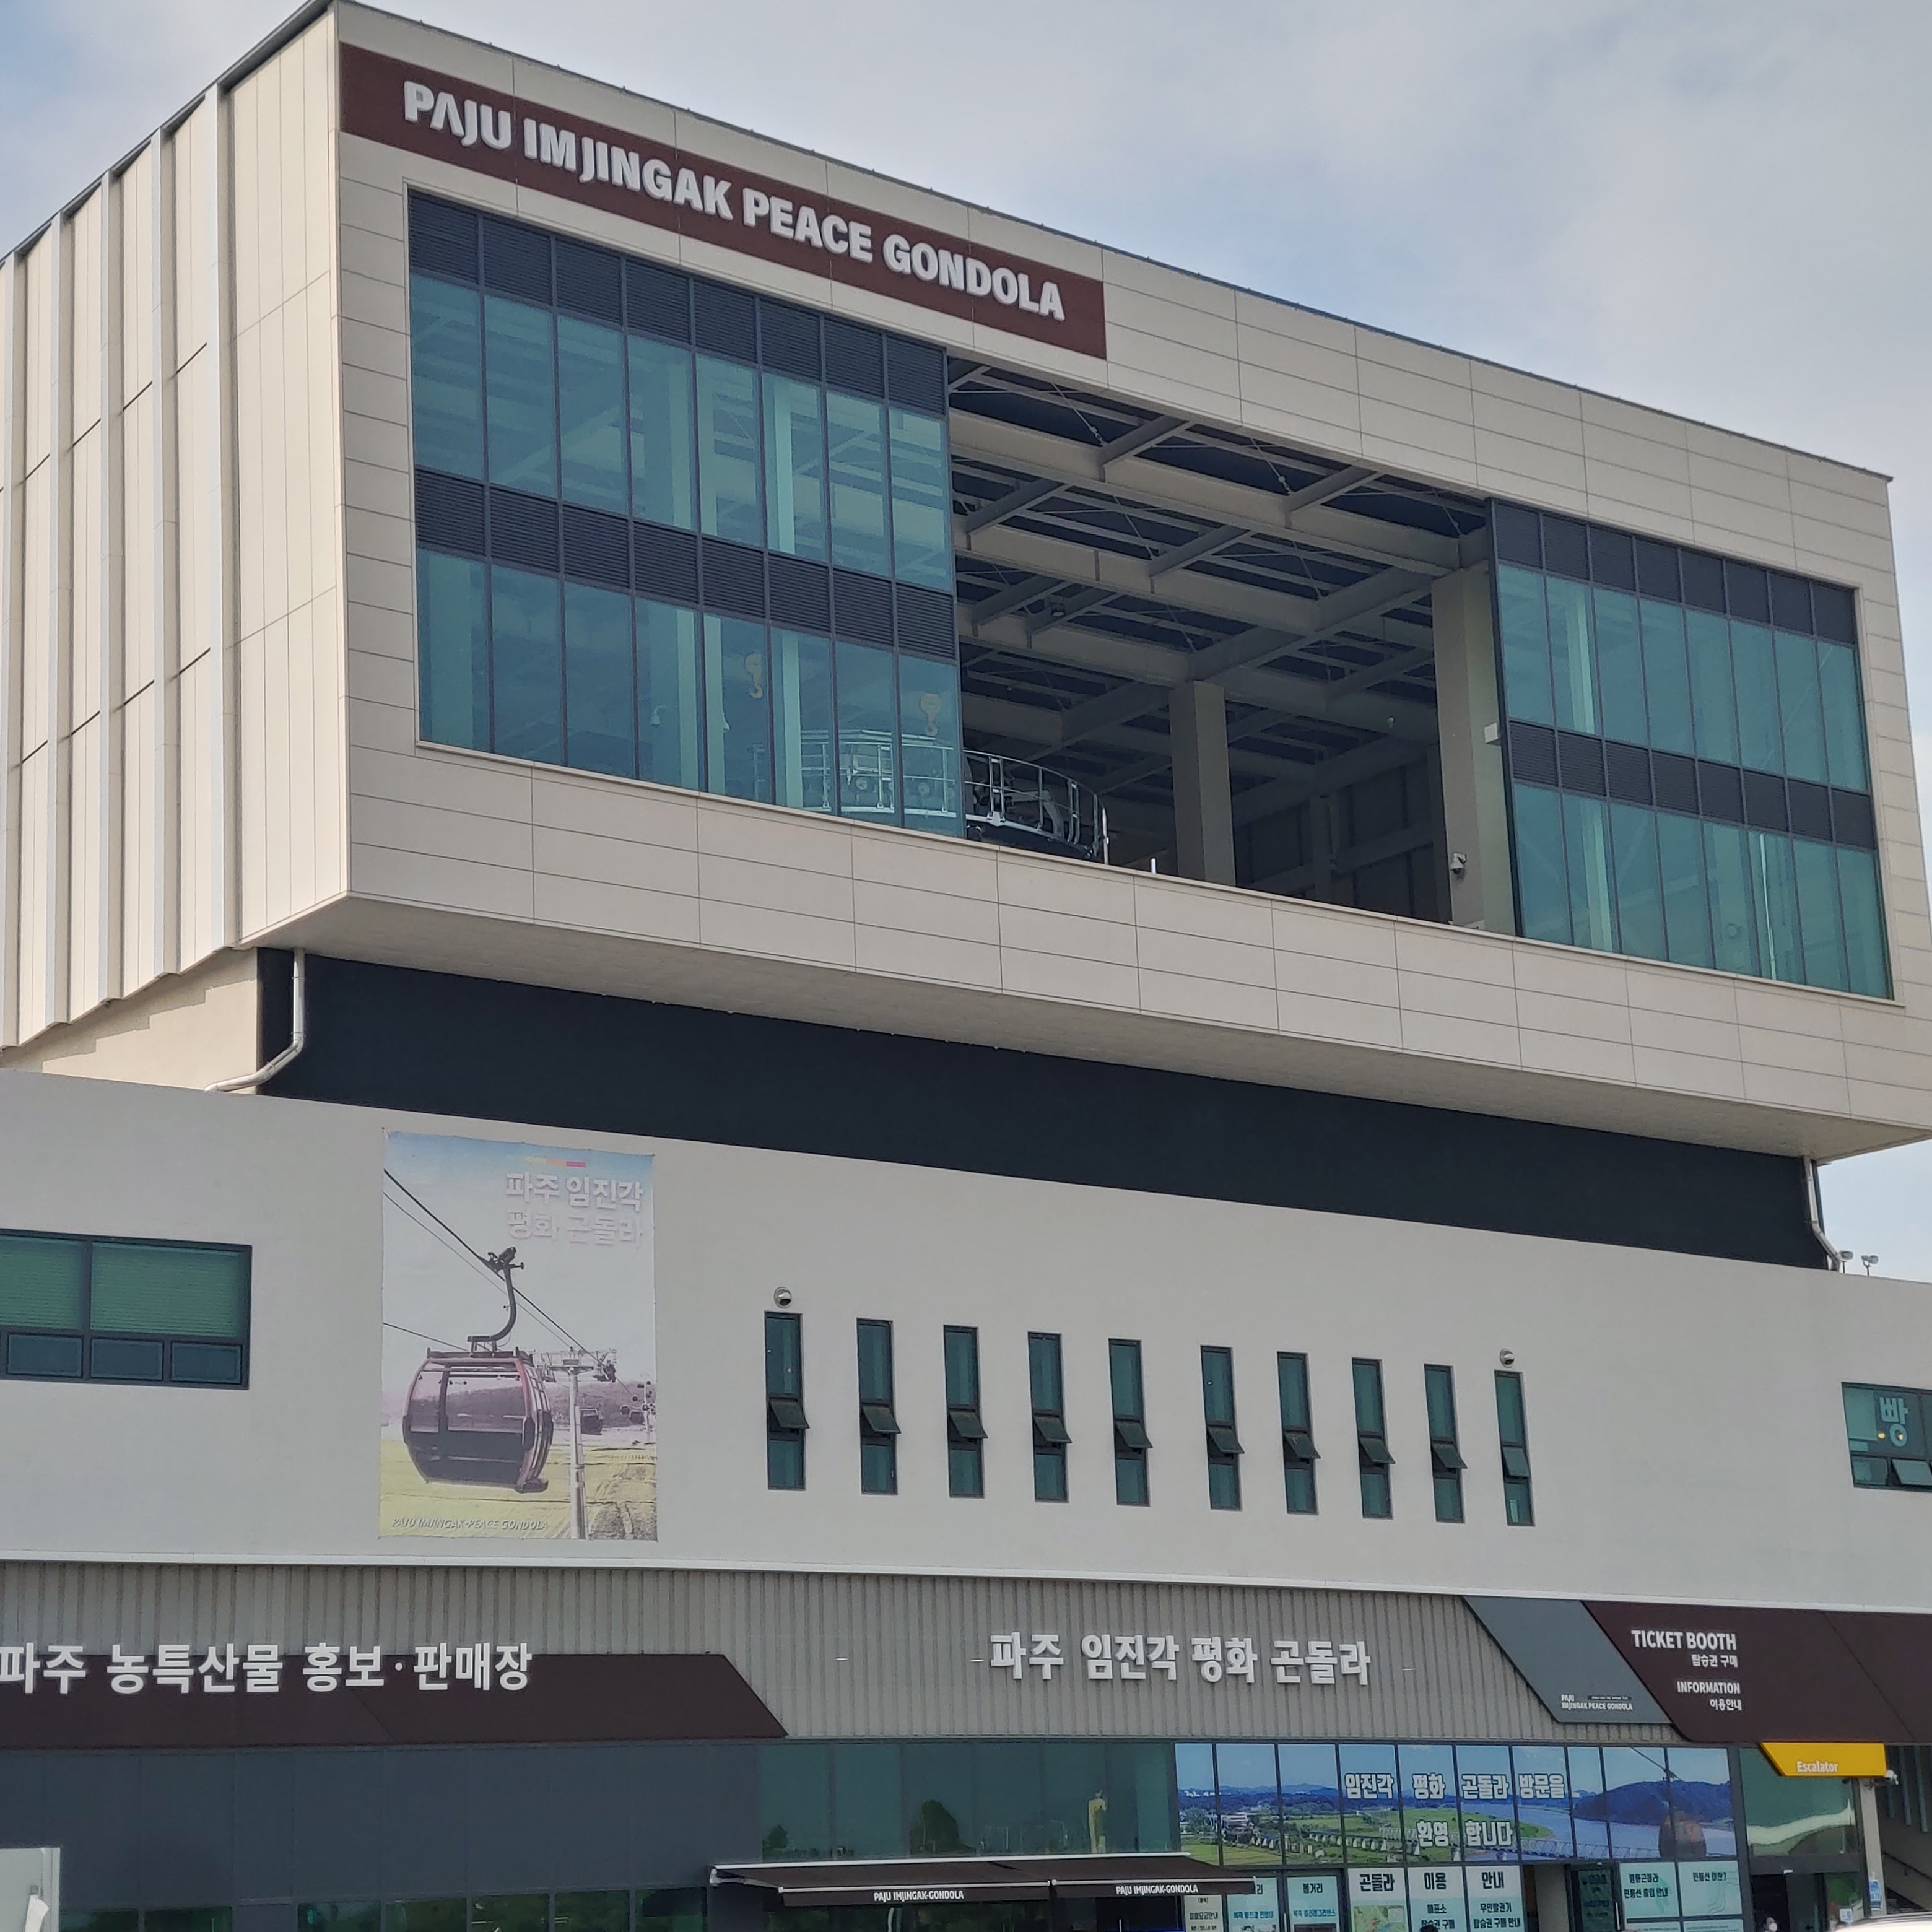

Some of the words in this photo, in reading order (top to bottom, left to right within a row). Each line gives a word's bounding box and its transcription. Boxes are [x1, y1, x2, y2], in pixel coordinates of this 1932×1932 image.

[404, 81, 512, 149] PAJU
[523, 118, 733, 220] IMJINGAK
[742, 187, 873, 263] PEACE
[883, 234, 1065, 321] GONDOLA
[505, 1172, 560, 1204] 파주
[566, 1175, 643, 1211] 임진각
[507, 1209, 559, 1239] 평화
[566, 1214, 643, 1247] 곤돌라
[1879, 1396, 1909, 1447] 빵
[392, 1518, 417, 1528] PAJU
[502, 1520, 549, 1530] GONDOLA
[1631, 1630, 1683, 1648] TICKET
[1686, 1632, 1736, 1650] BOOTH
[0, 1642, 86, 1694] 파주
[107, 1642, 284, 1694] 농특산물
[991, 1632, 1064, 1680] 파주
[1081, 1634, 1180, 1681] 임진각
[1191, 1637, 1258, 1683] 평화
[1271, 1640, 1371, 1686] 곤돌라
[1692, 1654, 1718, 1667] 탑승권
[1720, 1655, 1738, 1667] 구매
[1677, 1681, 1740, 1694] INFORMATION
[1710, 1699, 1742, 1711] 이용안내
[1796, 1760, 1838, 1772] Escalator
[1345, 1773, 1394, 1799] 임진각
[1412, 1772, 1445, 1799] 평화
[1461, 1774, 1510, 1799] 곤돌라
[1518, 1773, 1565, 1799] 방문을
[1416, 1820, 1449, 1847] 환영
[1465, 1821, 1513, 1847] 합니다
[1116, 1886, 1132, 1895] PAJU
[1133, 1884, 1199, 1895] IMJINGAK-GONDOLA
[1359, 1873, 1395, 1892] 곤돌라
[1424, 1872, 1447, 1890] 이용
[1481, 1871, 1505, 1889] 안내
[874, 1892, 891, 1902] PAJU
[893, 1891, 964, 1902] IMJINGAK-GONDOLA
[1508, 1918, 1521, 1928] 안내
